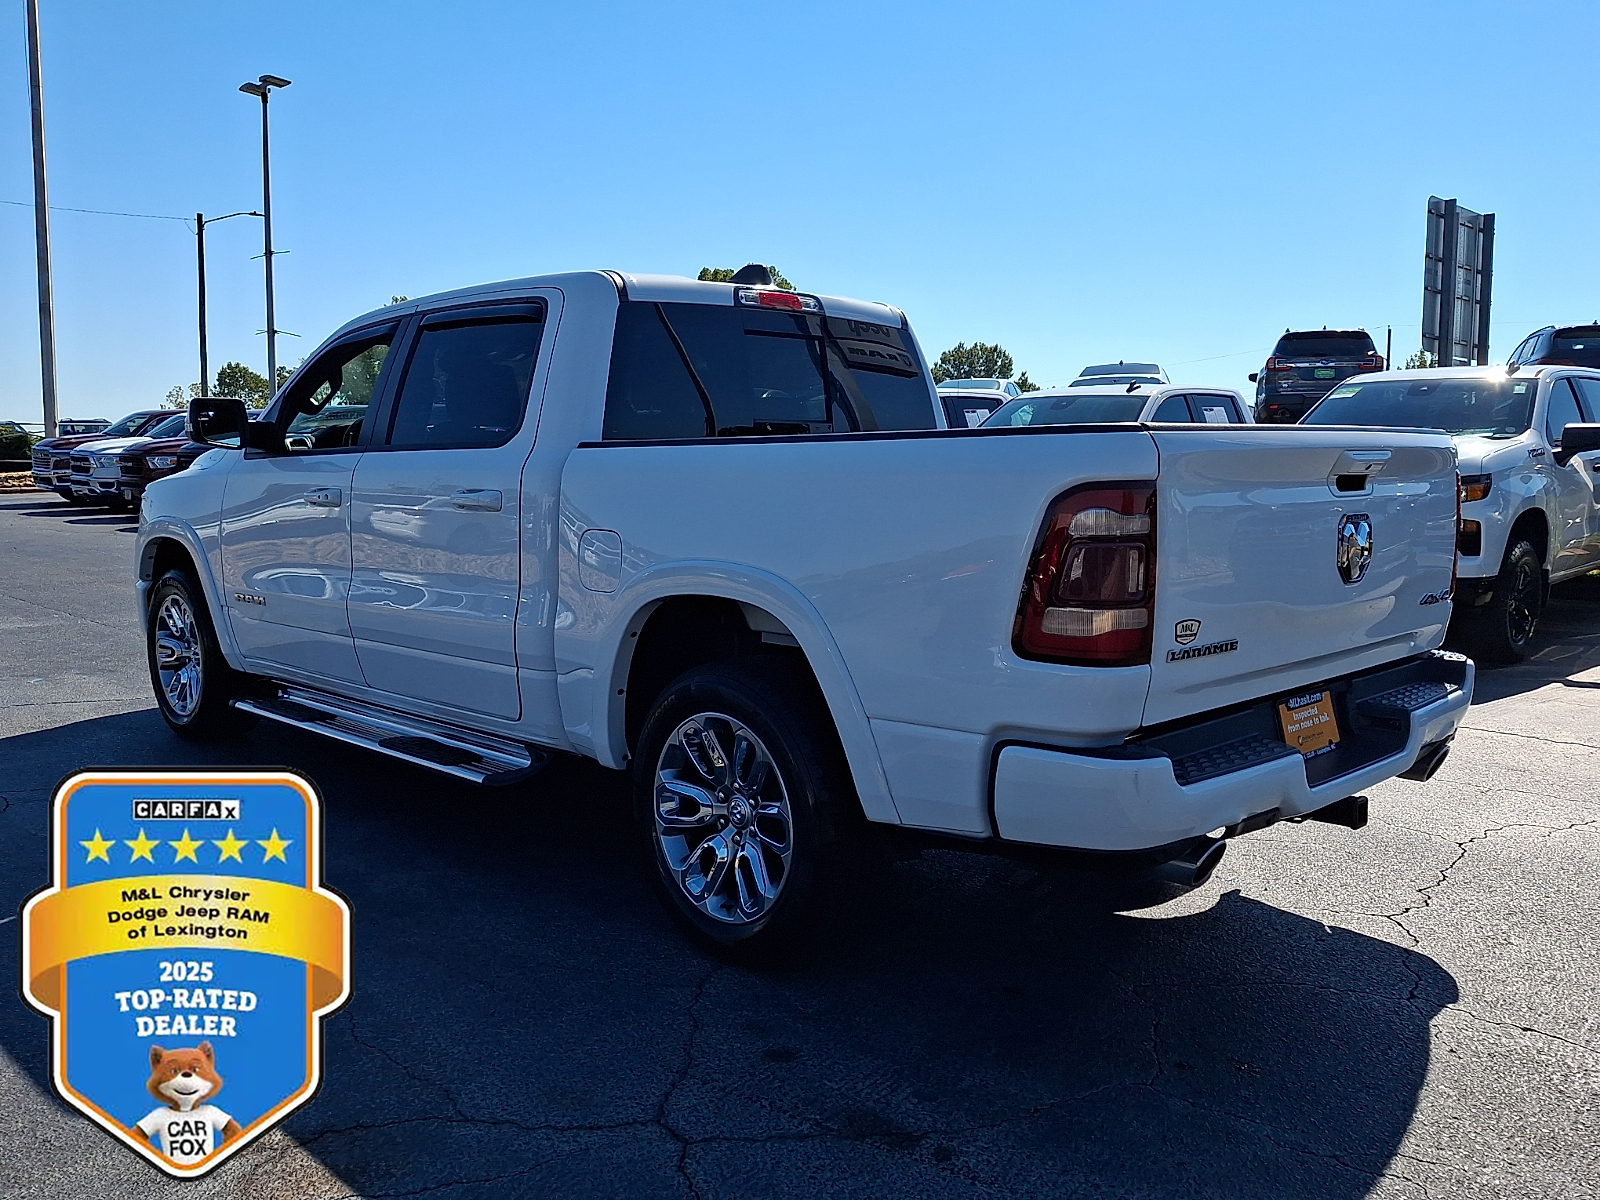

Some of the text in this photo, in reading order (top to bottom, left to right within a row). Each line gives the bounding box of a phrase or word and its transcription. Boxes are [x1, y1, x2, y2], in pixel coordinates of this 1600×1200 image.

[1168, 640, 1239, 662] LARAMIE
[1293, 705, 1318, 720] Inspected
[1288, 723, 1300, 733] from
[1301, 718, 1313, 729] nose
[1314, 716, 1319, 724] to
